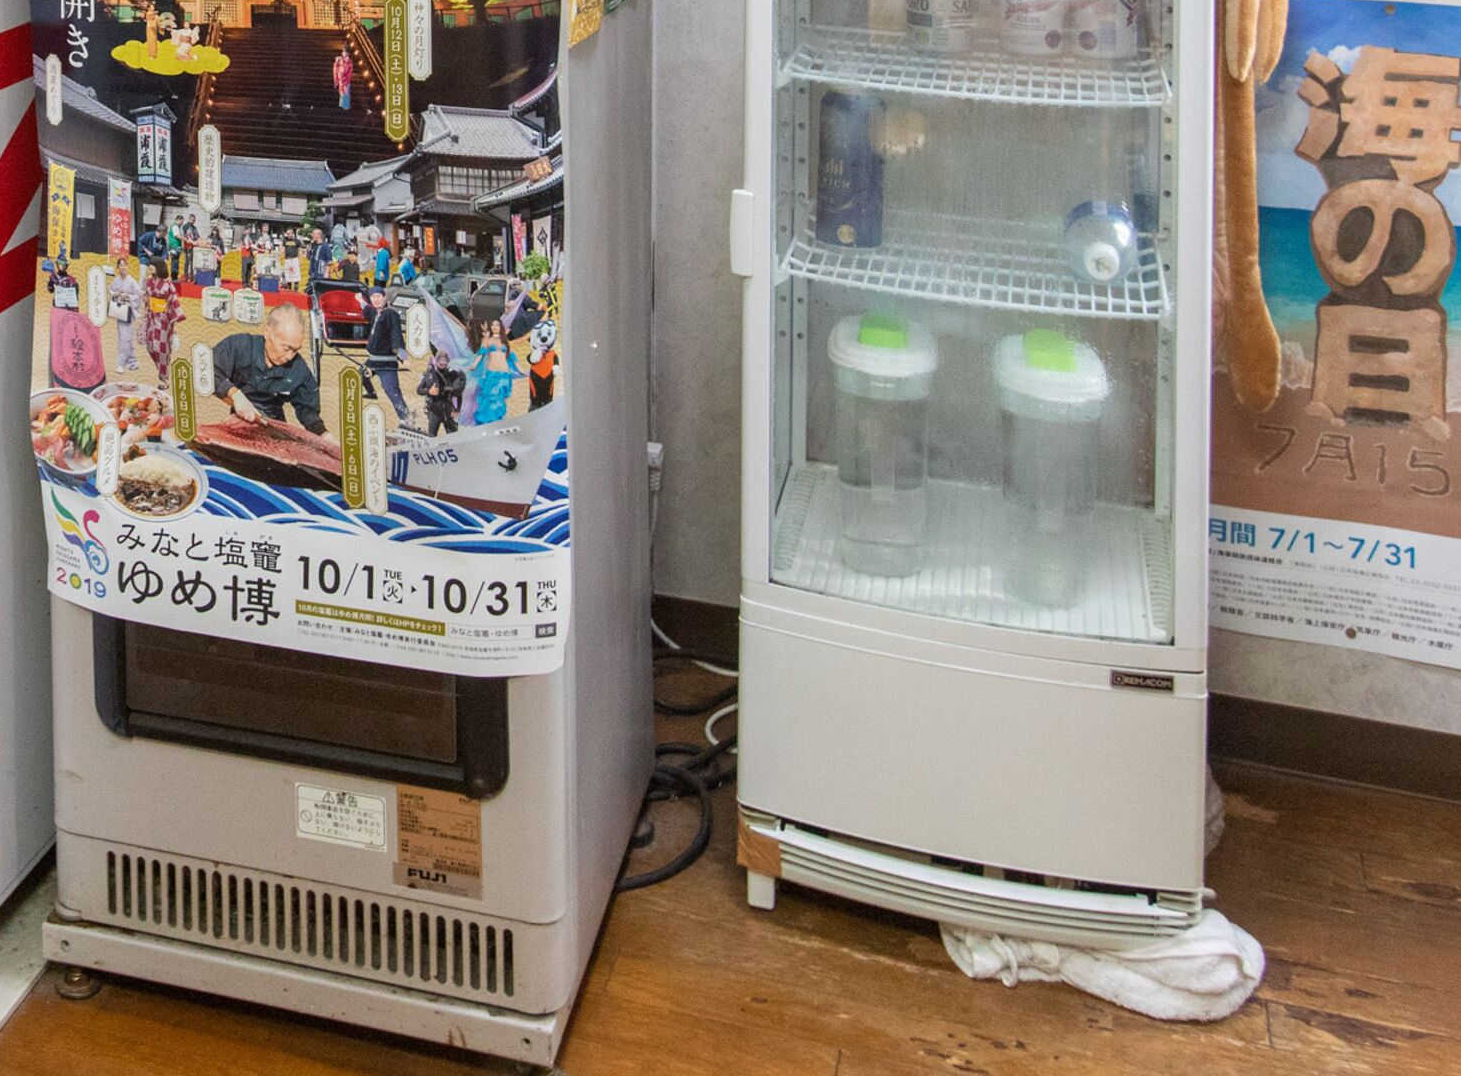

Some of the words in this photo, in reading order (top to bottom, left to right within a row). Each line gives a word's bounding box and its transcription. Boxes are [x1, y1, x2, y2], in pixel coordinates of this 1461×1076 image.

[1295, 45, 1461, 425] 海の日
[412, 450, 437, 466] PLH
[437, 447, 459, 465] 05
[116, 523, 283, 575] みなと塩竈
[55, 566, 107, 599] 2019
[117, 560, 281, 627] ゆめ博
[298, 555, 375, 600] 10/1
[383, 568, 403, 581] TUE
[422, 574, 529, 617] 10/31
[536, 579, 557, 590] THU
[538, 593, 555, 611] 木
